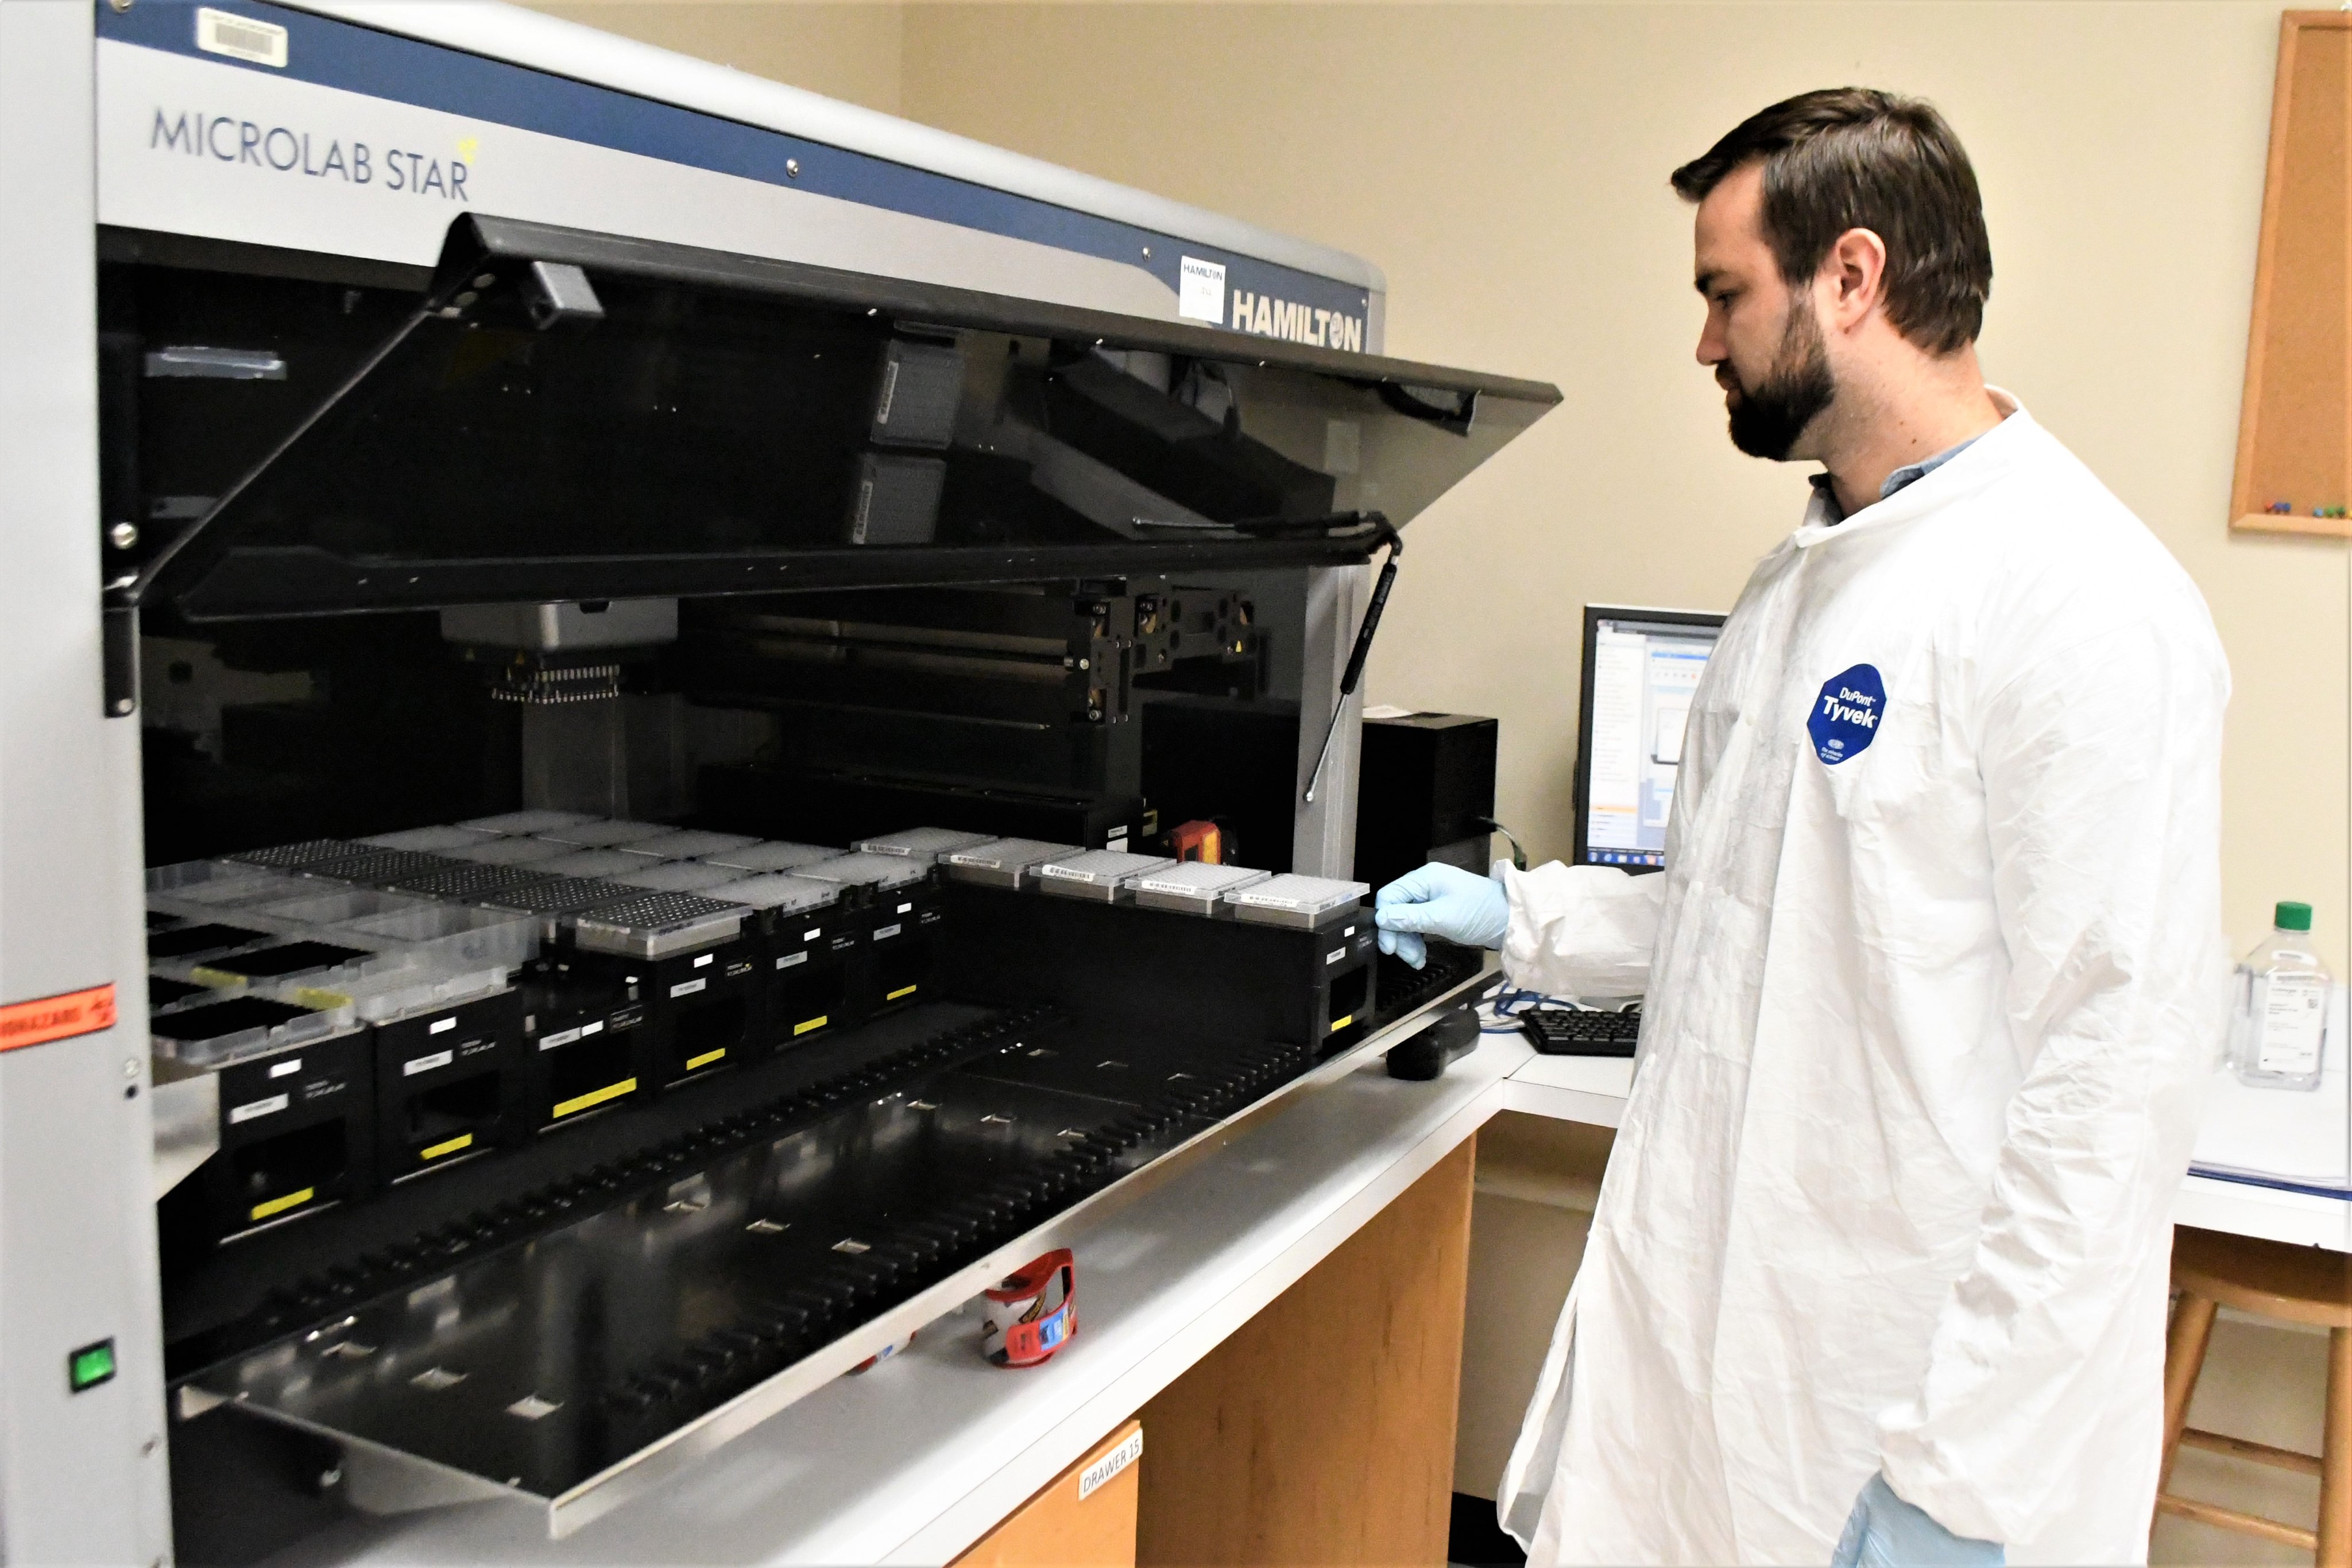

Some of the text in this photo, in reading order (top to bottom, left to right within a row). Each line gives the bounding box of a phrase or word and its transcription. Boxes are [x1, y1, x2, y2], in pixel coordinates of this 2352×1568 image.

[150, 106, 470, 202] MICROLAB STAR
[1183, 264, 1223, 281] HAMILTON
[1232, 289, 1361, 353] HAMILTON
[1823, 695, 1875, 729] Tyvek
[1839, 687, 1873, 707] DuPont
[1083, 1438, 1140, 1494] DRAWER 15
